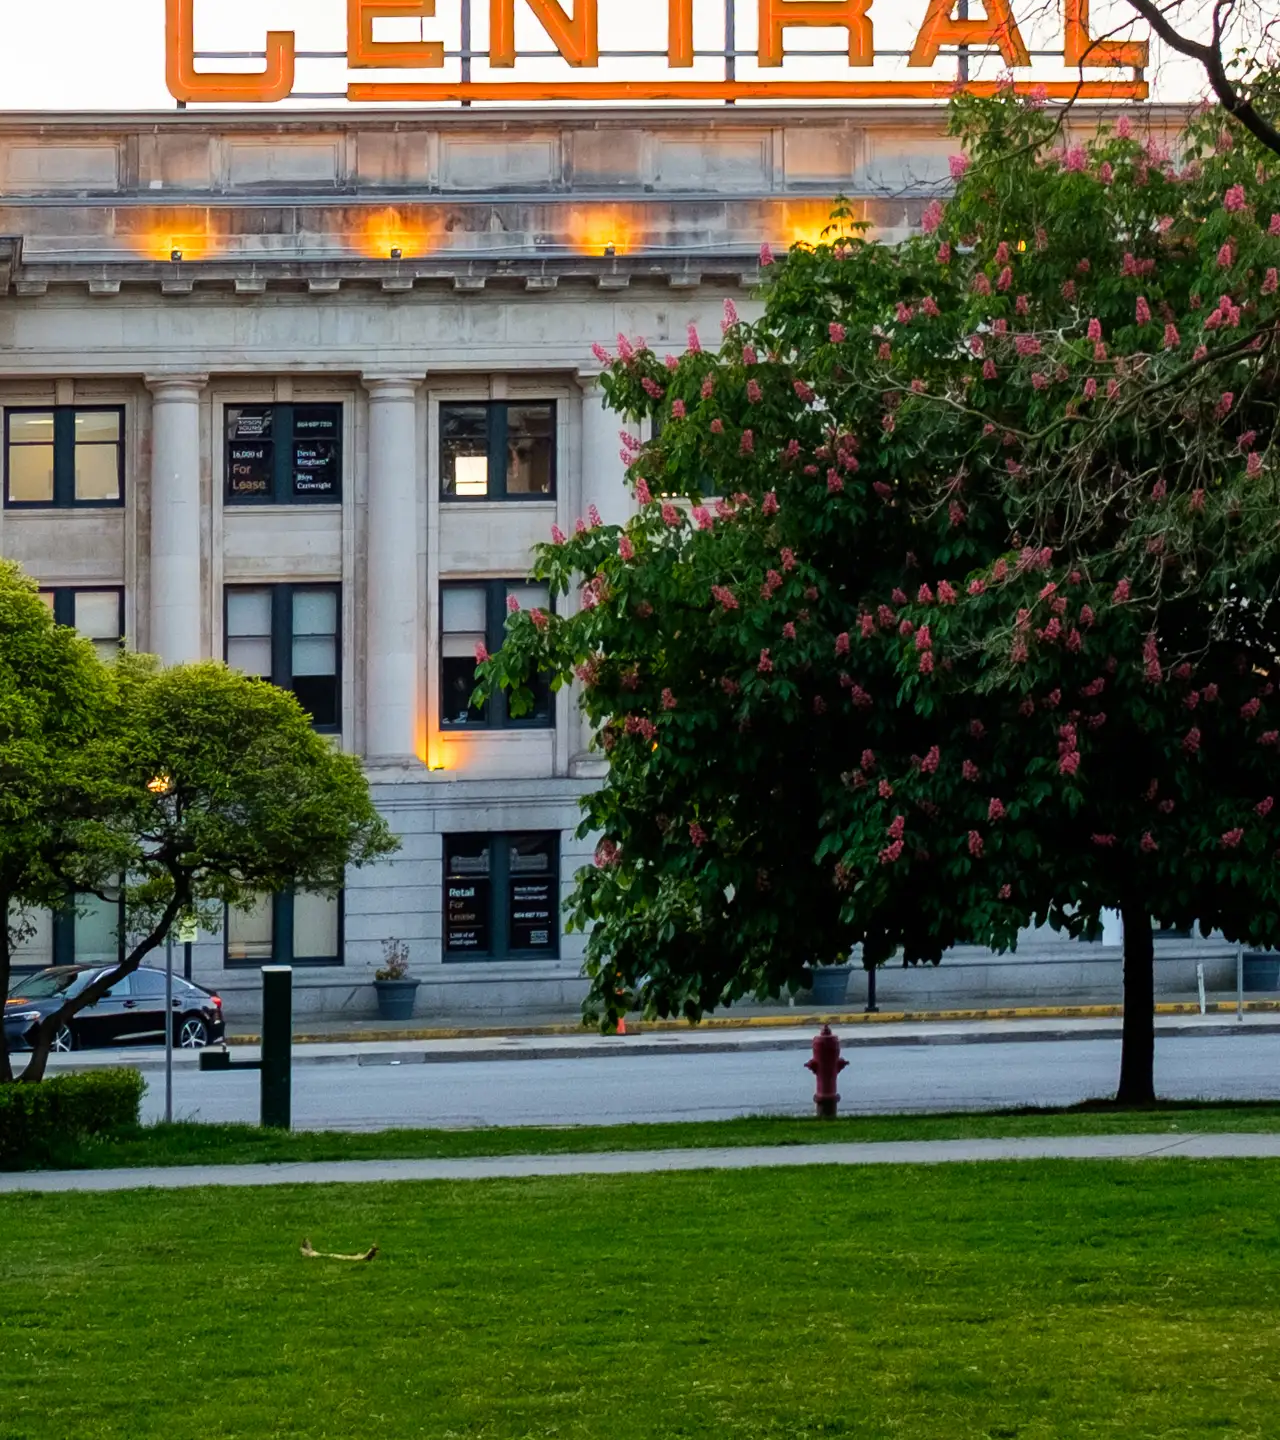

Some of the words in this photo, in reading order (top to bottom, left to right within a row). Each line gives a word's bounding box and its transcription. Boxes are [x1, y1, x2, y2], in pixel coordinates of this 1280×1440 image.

[232, 464, 252, 474] For
[232, 479, 267, 490] Lease
[449, 886, 475, 897] Retail
[449, 900, 465, 910] For
